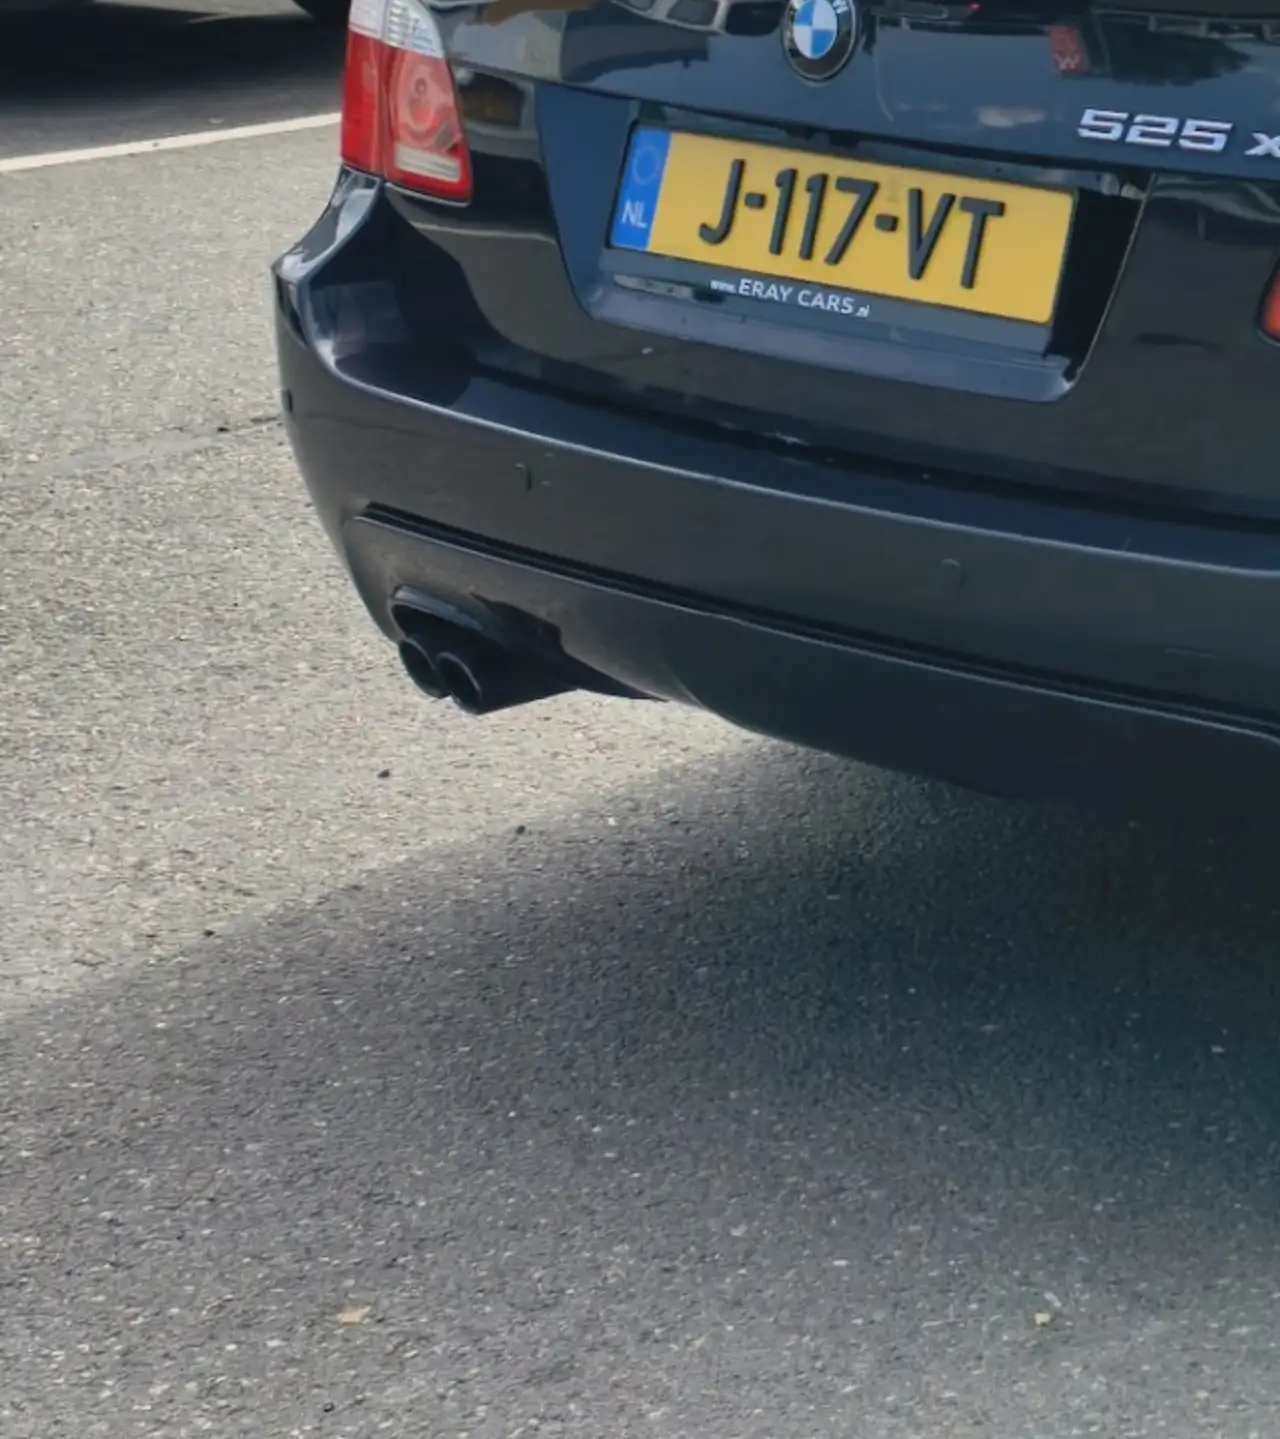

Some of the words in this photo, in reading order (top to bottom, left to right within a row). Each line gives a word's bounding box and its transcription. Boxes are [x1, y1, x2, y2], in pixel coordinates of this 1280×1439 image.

[1077, 108, 1234, 153] 525
[622, 199, 648, 229] NL
[698, 159, 1006, 290] J-117-VT
